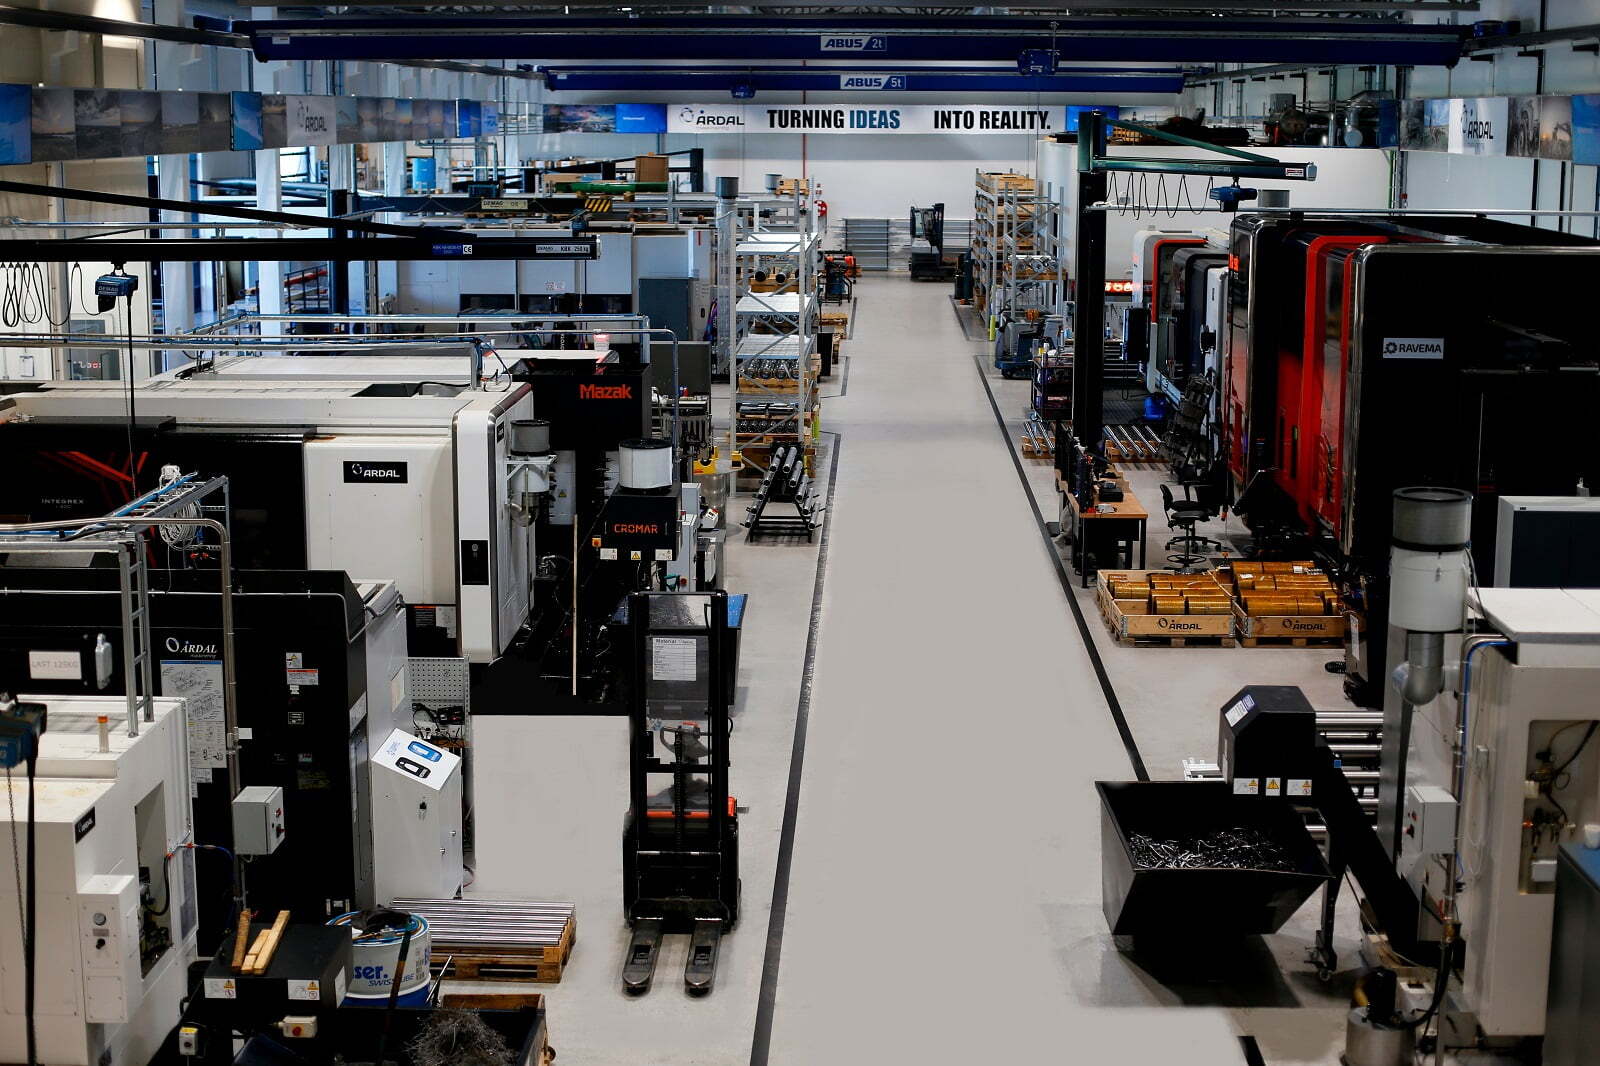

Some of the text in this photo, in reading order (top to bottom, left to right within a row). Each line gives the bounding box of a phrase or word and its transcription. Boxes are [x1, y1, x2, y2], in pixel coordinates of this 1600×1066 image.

[824, 38, 883, 49] ABUS 2t
[844, 77, 903, 88] ABUS 5t
[766, 109, 1051, 130] TURNING IDEAS INTO REALITY.
[1398, 343, 1442, 354] RAVEMA
[579, 383, 633, 400] Mazak
[613, 523, 658, 534] CROMAR
